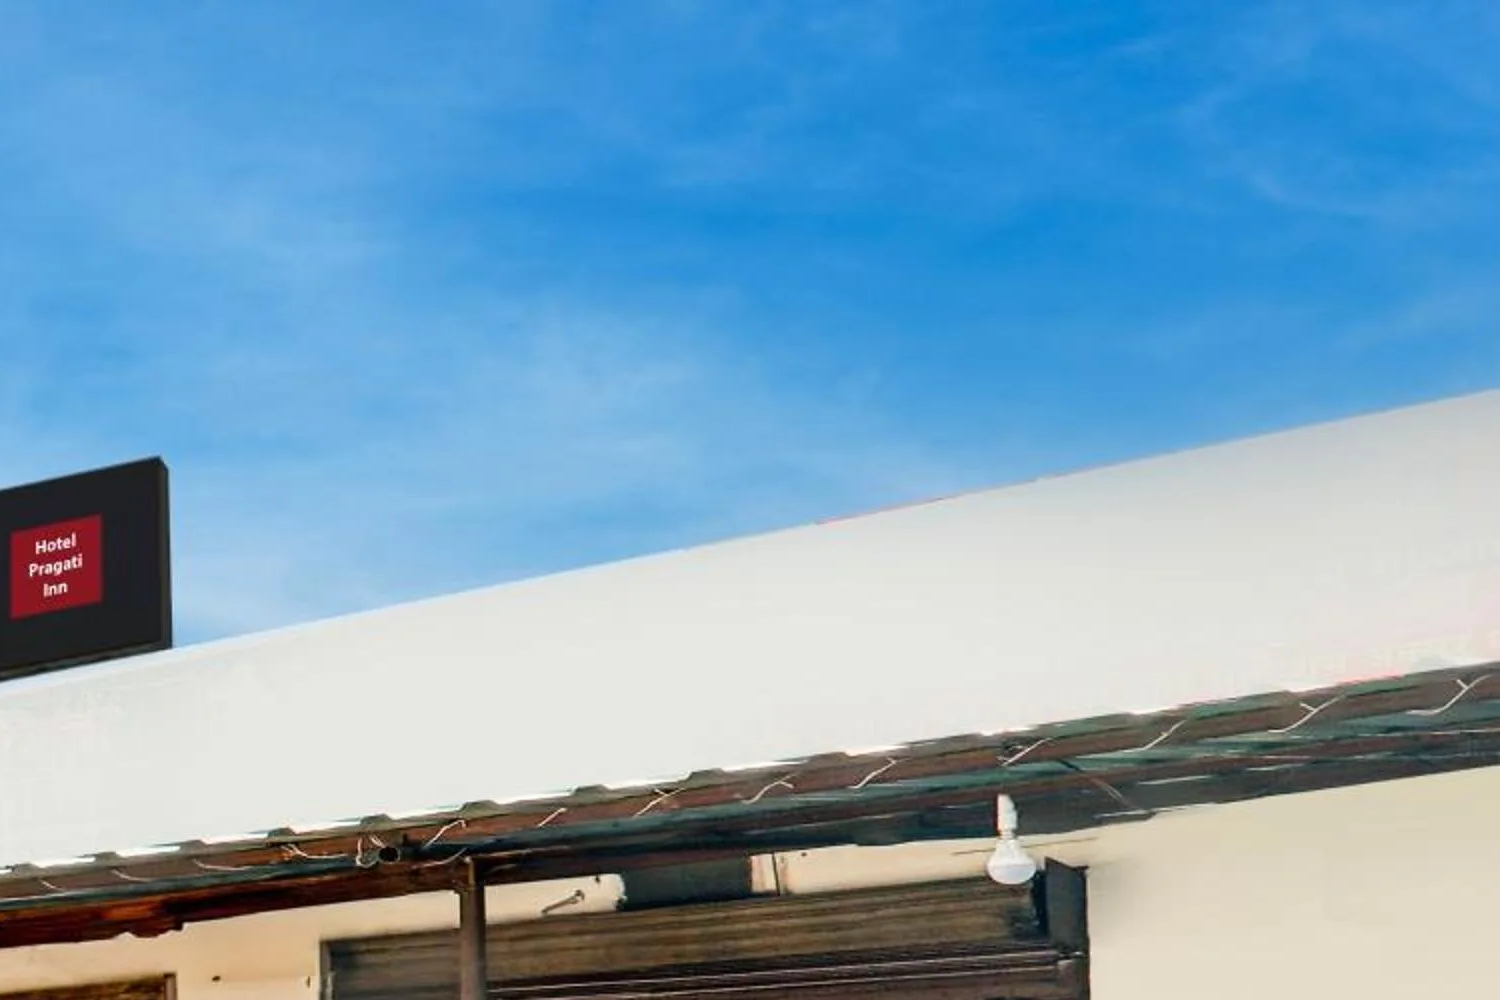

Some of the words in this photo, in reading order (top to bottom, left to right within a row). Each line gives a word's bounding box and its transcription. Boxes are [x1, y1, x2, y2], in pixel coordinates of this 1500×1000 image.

[35, 532, 77, 555] Hotel
[28, 553, 83, 577] Pragati
[43, 582, 68, 598] Inn
